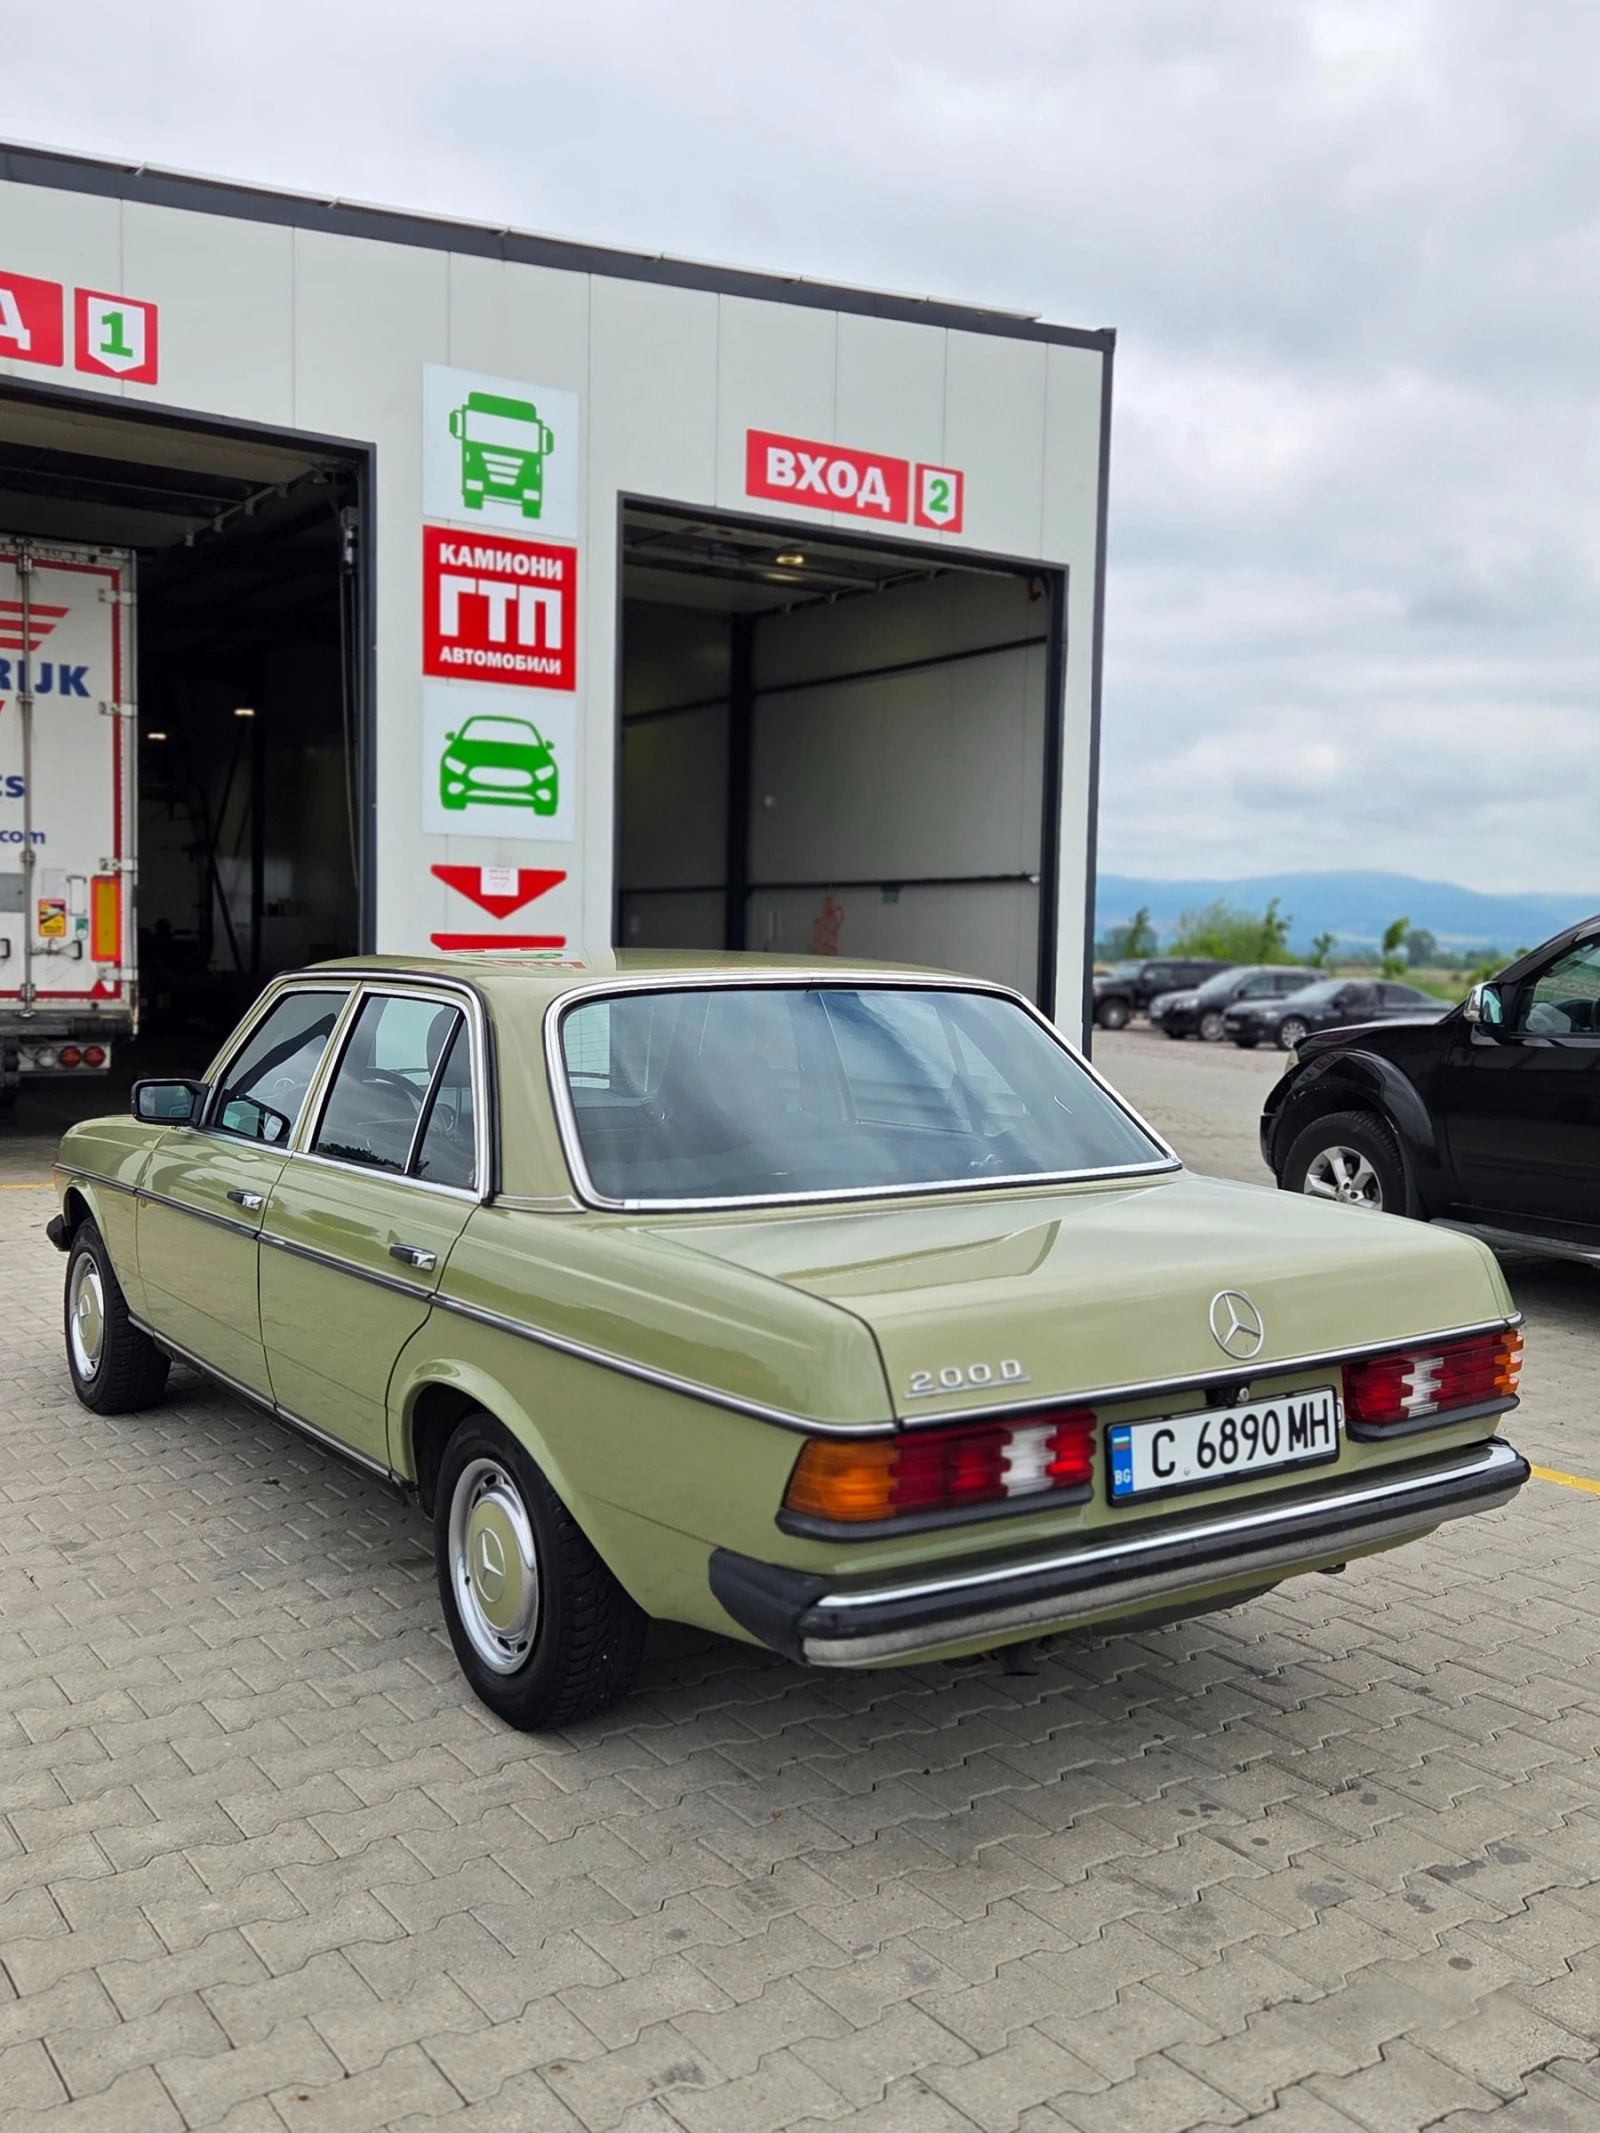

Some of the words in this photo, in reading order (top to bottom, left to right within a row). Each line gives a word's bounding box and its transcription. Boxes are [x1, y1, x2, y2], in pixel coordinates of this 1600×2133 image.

[100, 311, 133, 358] 1
[767, 446, 891, 513] ВХОД
[928, 478, 950, 513] 2
[440, 543, 563, 581] КАМИОНИ
[440, 573, 562, 650] ГТП
[440, 645, 561, 675] АВТОМОБИЛИ
[1151, 1428, 1176, 1478] C
[1196, 1408, 1281, 1469] 6890
[1288, 1399, 1330, 1453] MH
[1114, 1467, 1132, 1486] BG
